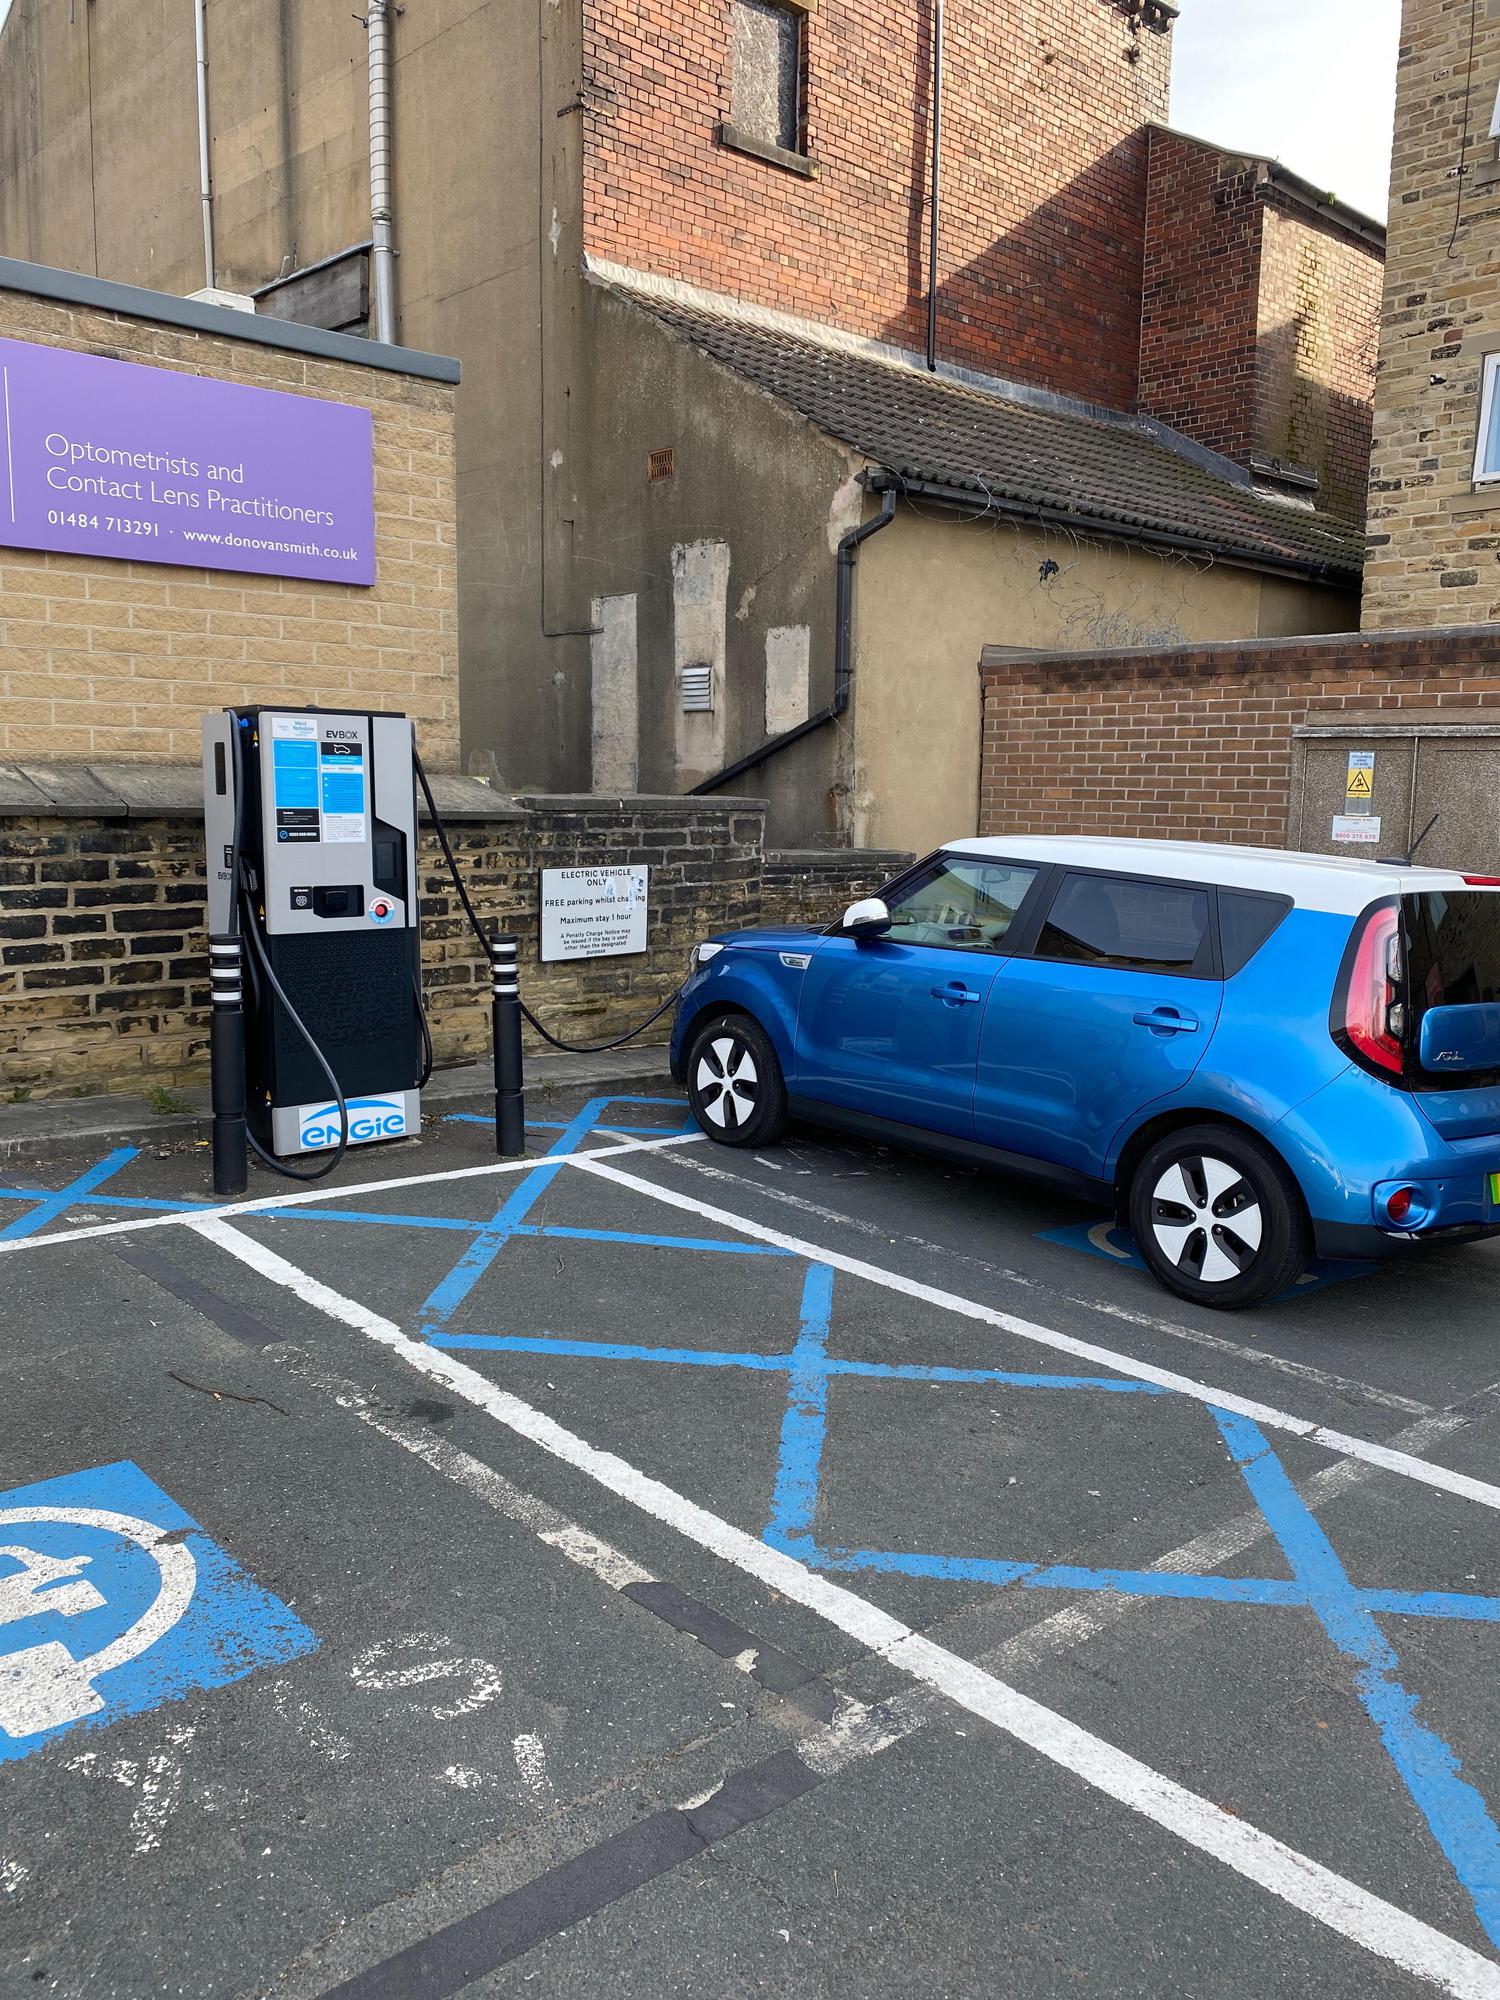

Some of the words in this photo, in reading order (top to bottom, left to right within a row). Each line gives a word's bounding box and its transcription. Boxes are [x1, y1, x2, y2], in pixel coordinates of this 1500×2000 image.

[45, 433, 200, 477] Optometrists
[207, 463, 244, 484] and
[46, 466, 144, 501] Contact
[150, 481, 200, 509] Lens
[207, 489, 335, 526] Practitioners
[47, 509, 99, 530] 01484
[105, 516, 159, 537] 713291
[183, 530, 358, 561] www.donovansmith.co.uk
[326, 730, 358, 739] EVBOX
[561, 870, 598, 879] ELECTRIC
[600, 868, 631, 877] VEHICLE
[586, 878, 607, 886] ONLY
[545, 899, 565, 907] FREE
[566, 896, 593, 907] parking
[595, 896, 616, 904] whilst
[617, 894, 646, 903] chaing
[560, 916, 594, 924] Maximum
[595, 914, 610, 923] stay
[611, 913, 615, 921] 1
[616, 913, 632, 921] hour
[600, 940, 627, 948] designated
[586, 948, 606, 956] purpose
